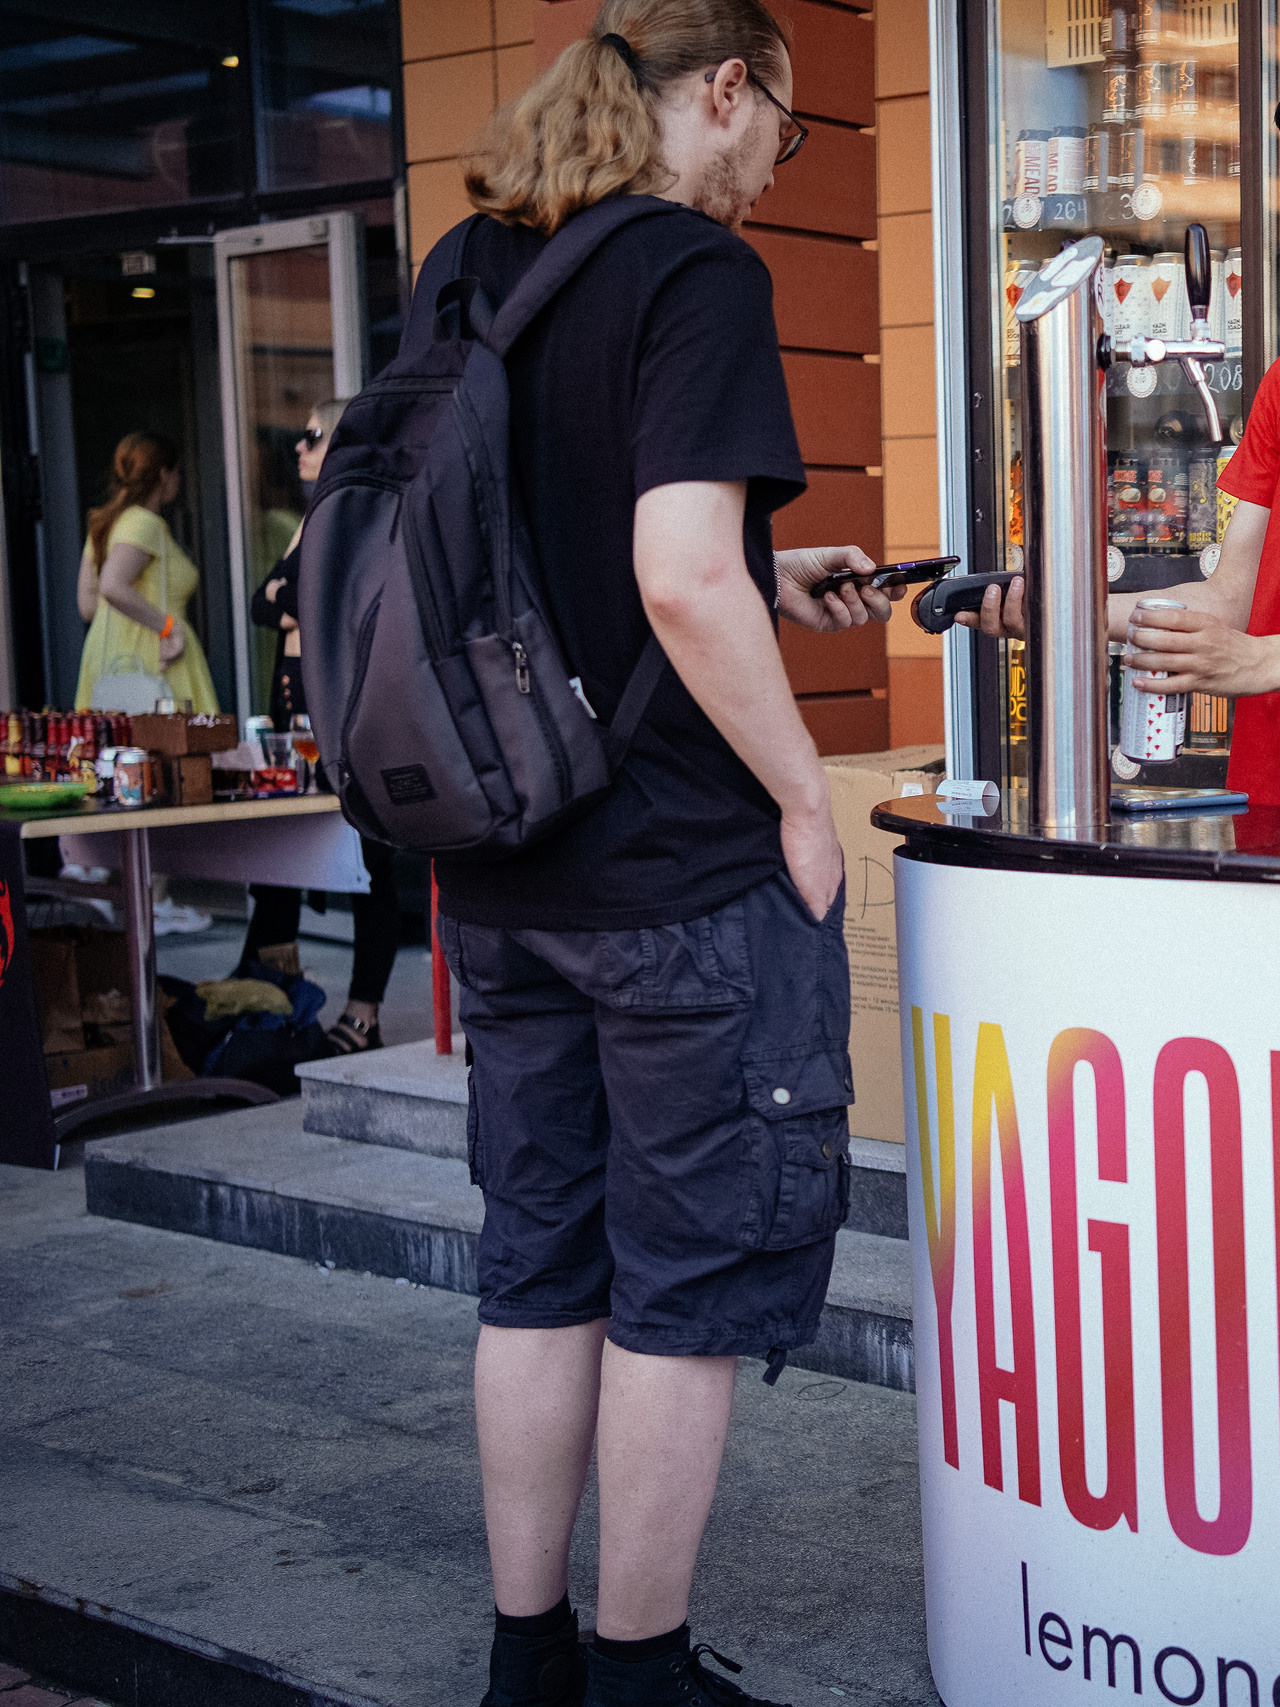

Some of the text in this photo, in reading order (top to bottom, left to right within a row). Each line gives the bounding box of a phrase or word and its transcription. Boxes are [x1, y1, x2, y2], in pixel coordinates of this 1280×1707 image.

[1024, 156, 1041, 195] MEAD
[1047, 152, 1059, 193] MEAD
[1203, 363, 1242, 393] 208
